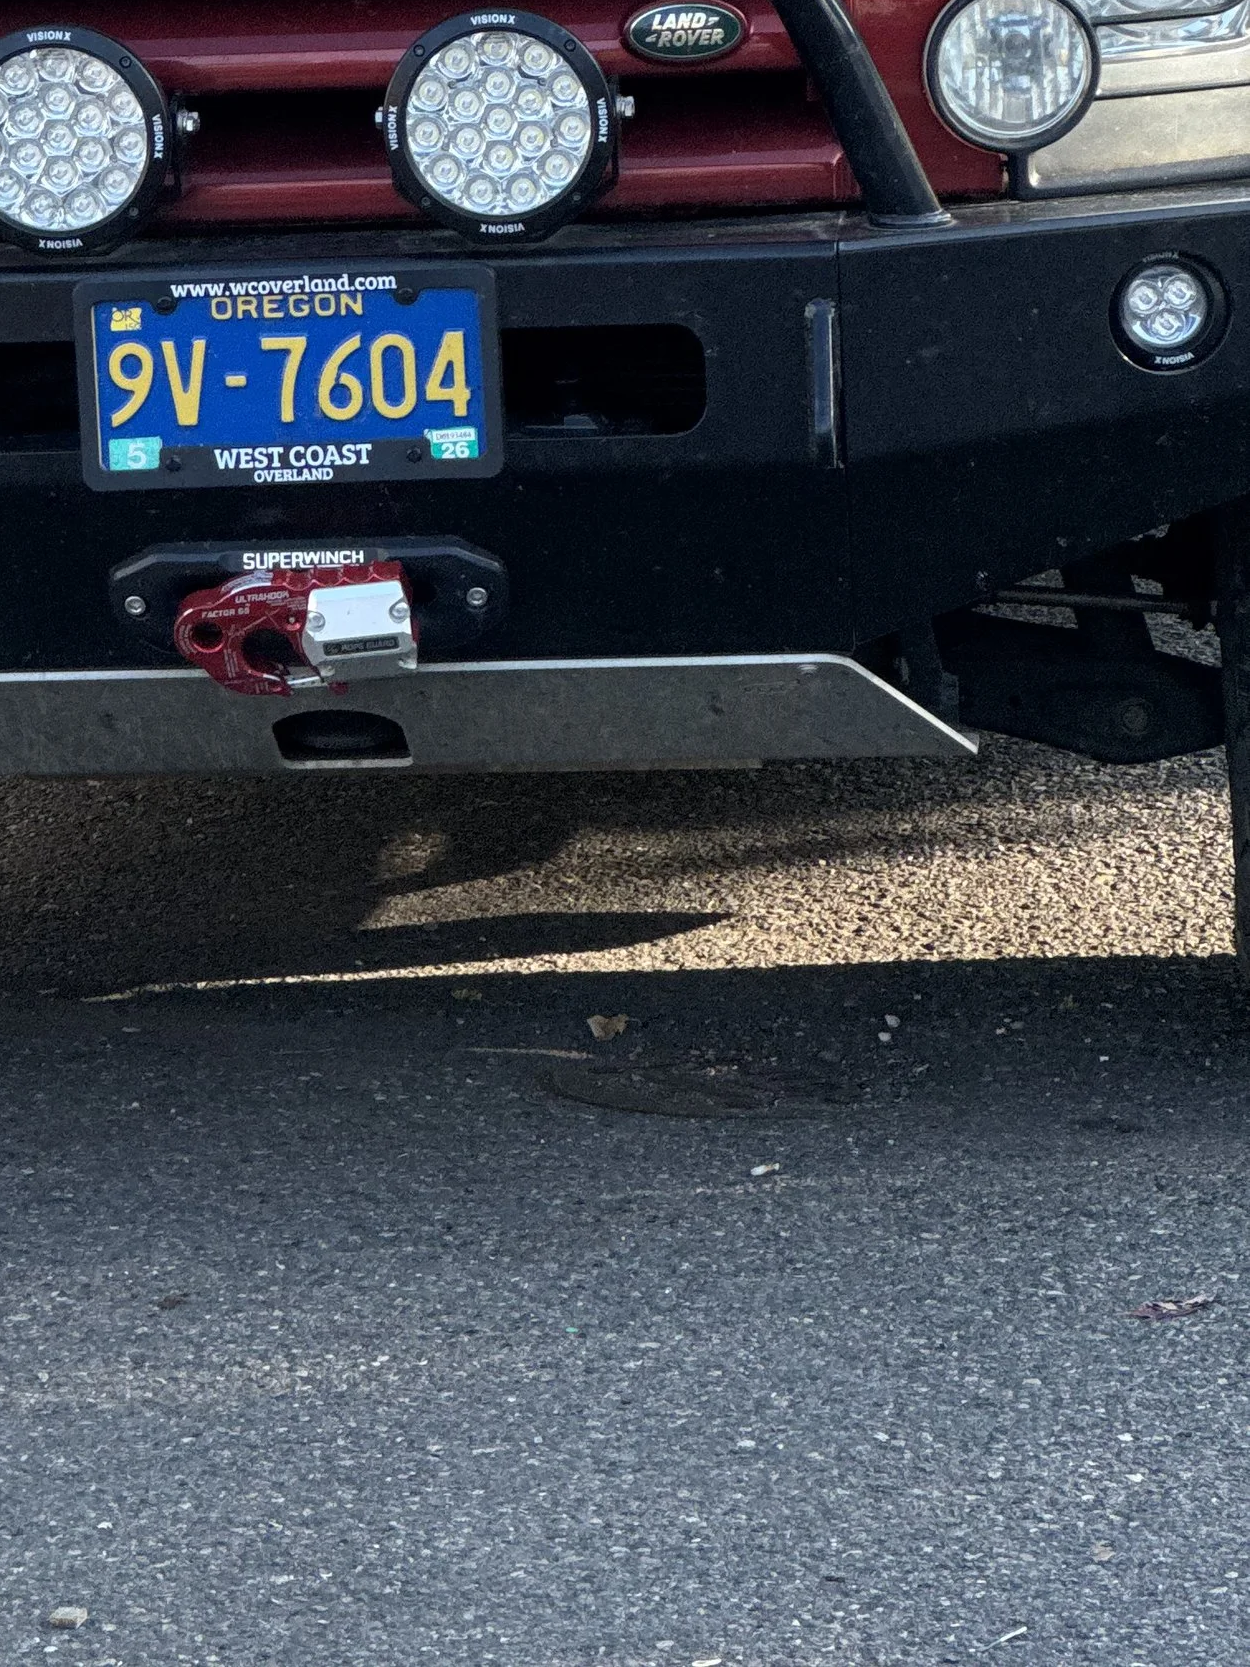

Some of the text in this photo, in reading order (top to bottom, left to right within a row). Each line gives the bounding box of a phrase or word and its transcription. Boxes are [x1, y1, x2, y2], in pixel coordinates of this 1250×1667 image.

[651, 12, 707, 31] LAND
[657, 28, 725, 48] ROVER
[170, 274, 397, 298] www.wcoverland.com
[211, 293, 364, 321] OREGON
[108, 329, 472, 428] 9V-7604
[127, 442, 147, 469] 5
[214, 443, 372, 470] WEST COAST
[441, 441, 470, 459] 26
[254, 467, 334, 483] OVERLAND
[243, 550, 364, 570] SUPERWINCH
